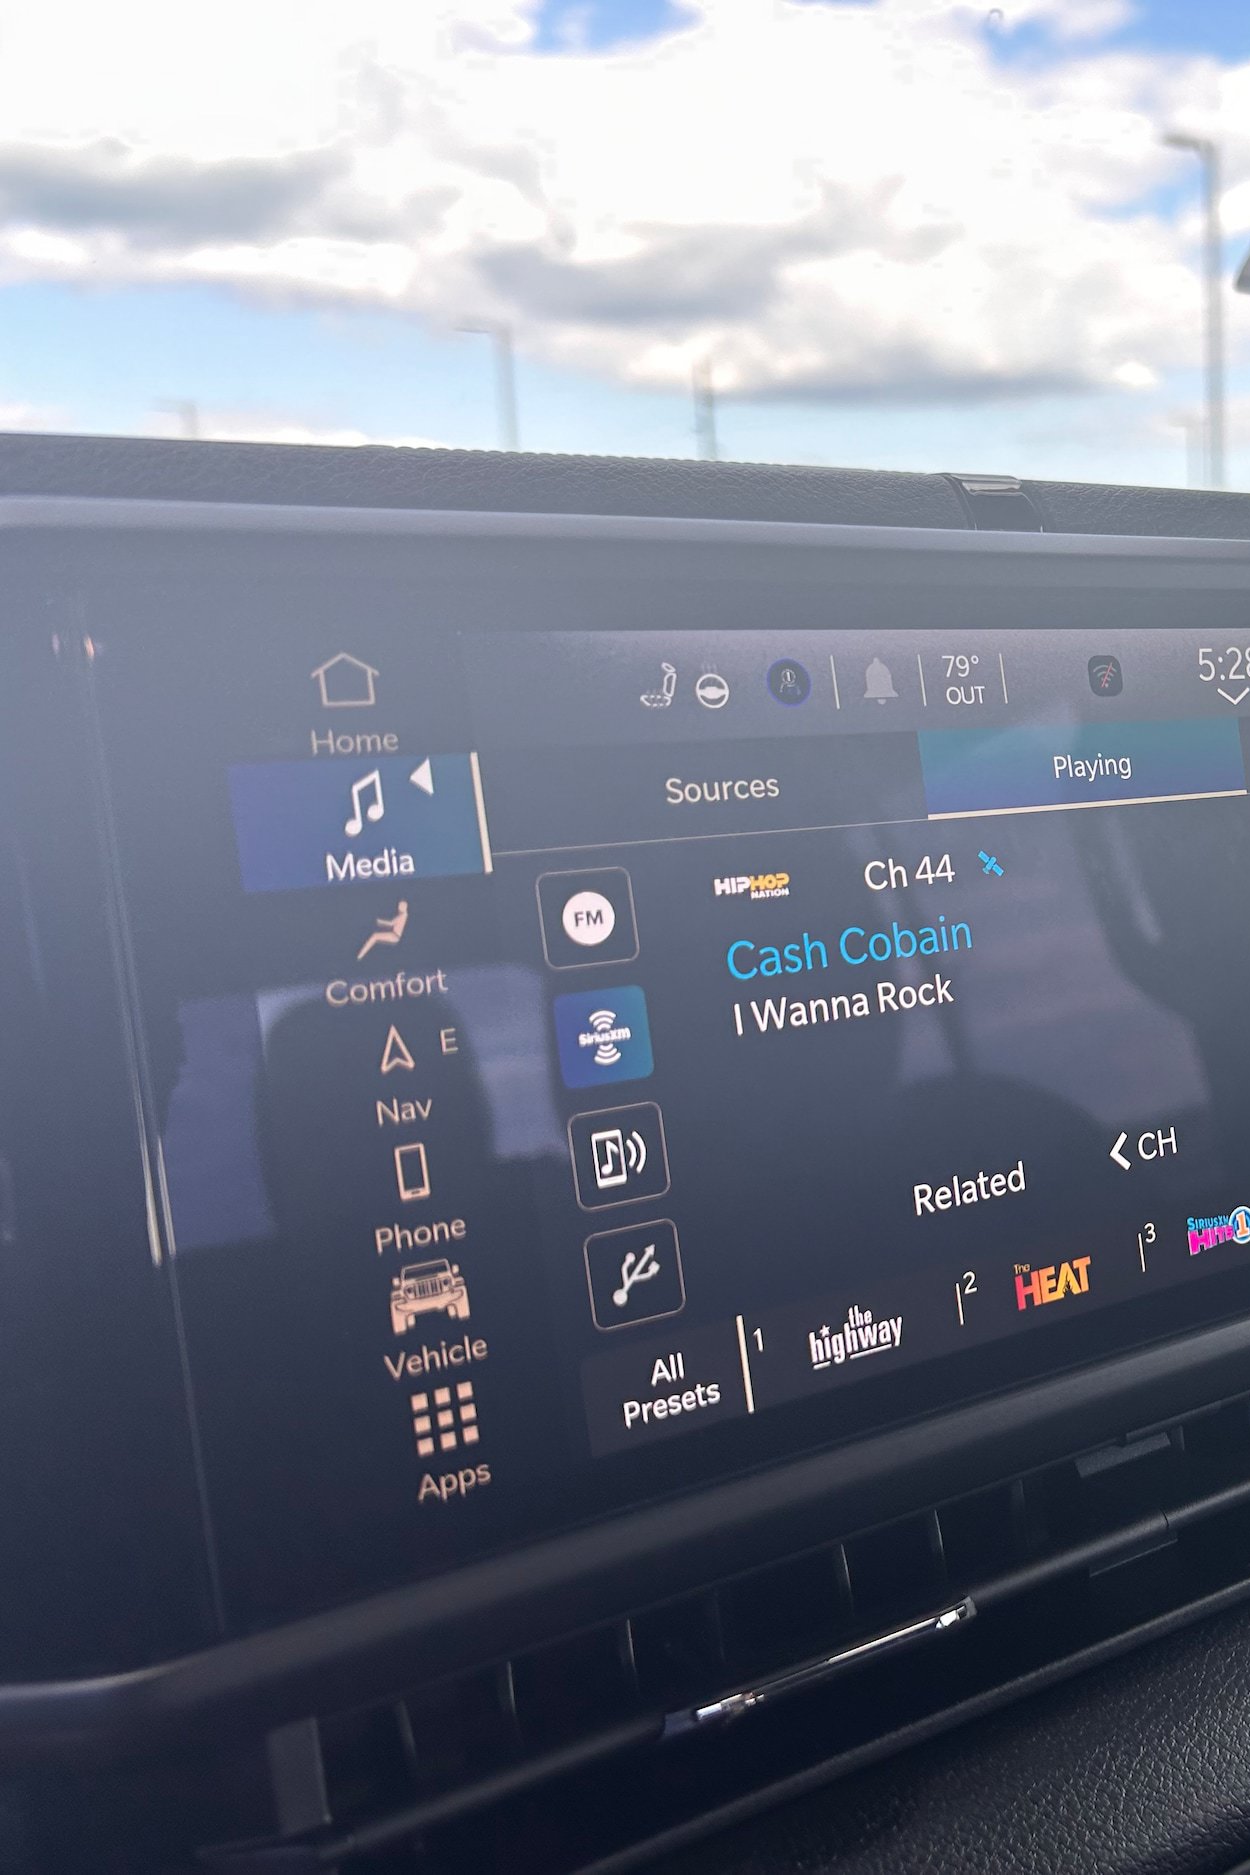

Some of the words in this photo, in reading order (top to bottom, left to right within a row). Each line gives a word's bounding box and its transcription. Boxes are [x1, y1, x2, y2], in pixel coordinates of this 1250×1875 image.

[942, 655, 979, 678] 79°
[946, 686, 985, 706] OUT
[311, 729, 399, 756] Home
[1053, 753, 1133, 782] Playing
[665, 775, 780, 805] Sources
[326, 848, 415, 882] Media
[864, 858, 908, 891] Ch
[915, 854, 956, 884] 44
[750, 887, 790, 900] NATION
[573, 908, 604, 928] FM
[727, 933, 829, 981] Cash
[839, 915, 973, 967] Cobain
[326, 968, 448, 1007] Comfort
[733, 1003, 743, 1036] I
[752, 988, 871, 1033] Wanna
[878, 973, 954, 1014] Rock
[440, 1028, 459, 1056] E
[376, 1097, 433, 1127] Nav
[1137, 1126, 1178, 1161] CH
[913, 1160, 1026, 1216] Related
[375, 1216, 467, 1255] Phone
[1144, 1223, 1157, 1243] 3
[1187, 1224, 1235, 1257] HITS
[963, 1273, 978, 1294] 2
[1014, 1255, 1092, 1312] HEAT
[848, 1304, 873, 1328] the
[753, 1328, 764, 1352] 1
[808, 1316, 903, 1365] highway
[383, 1335, 488, 1381] Vehicle
[650, 1352, 684, 1387] All
[622, 1380, 722, 1430] Presets
[418, 1463, 492, 1504] Apps
